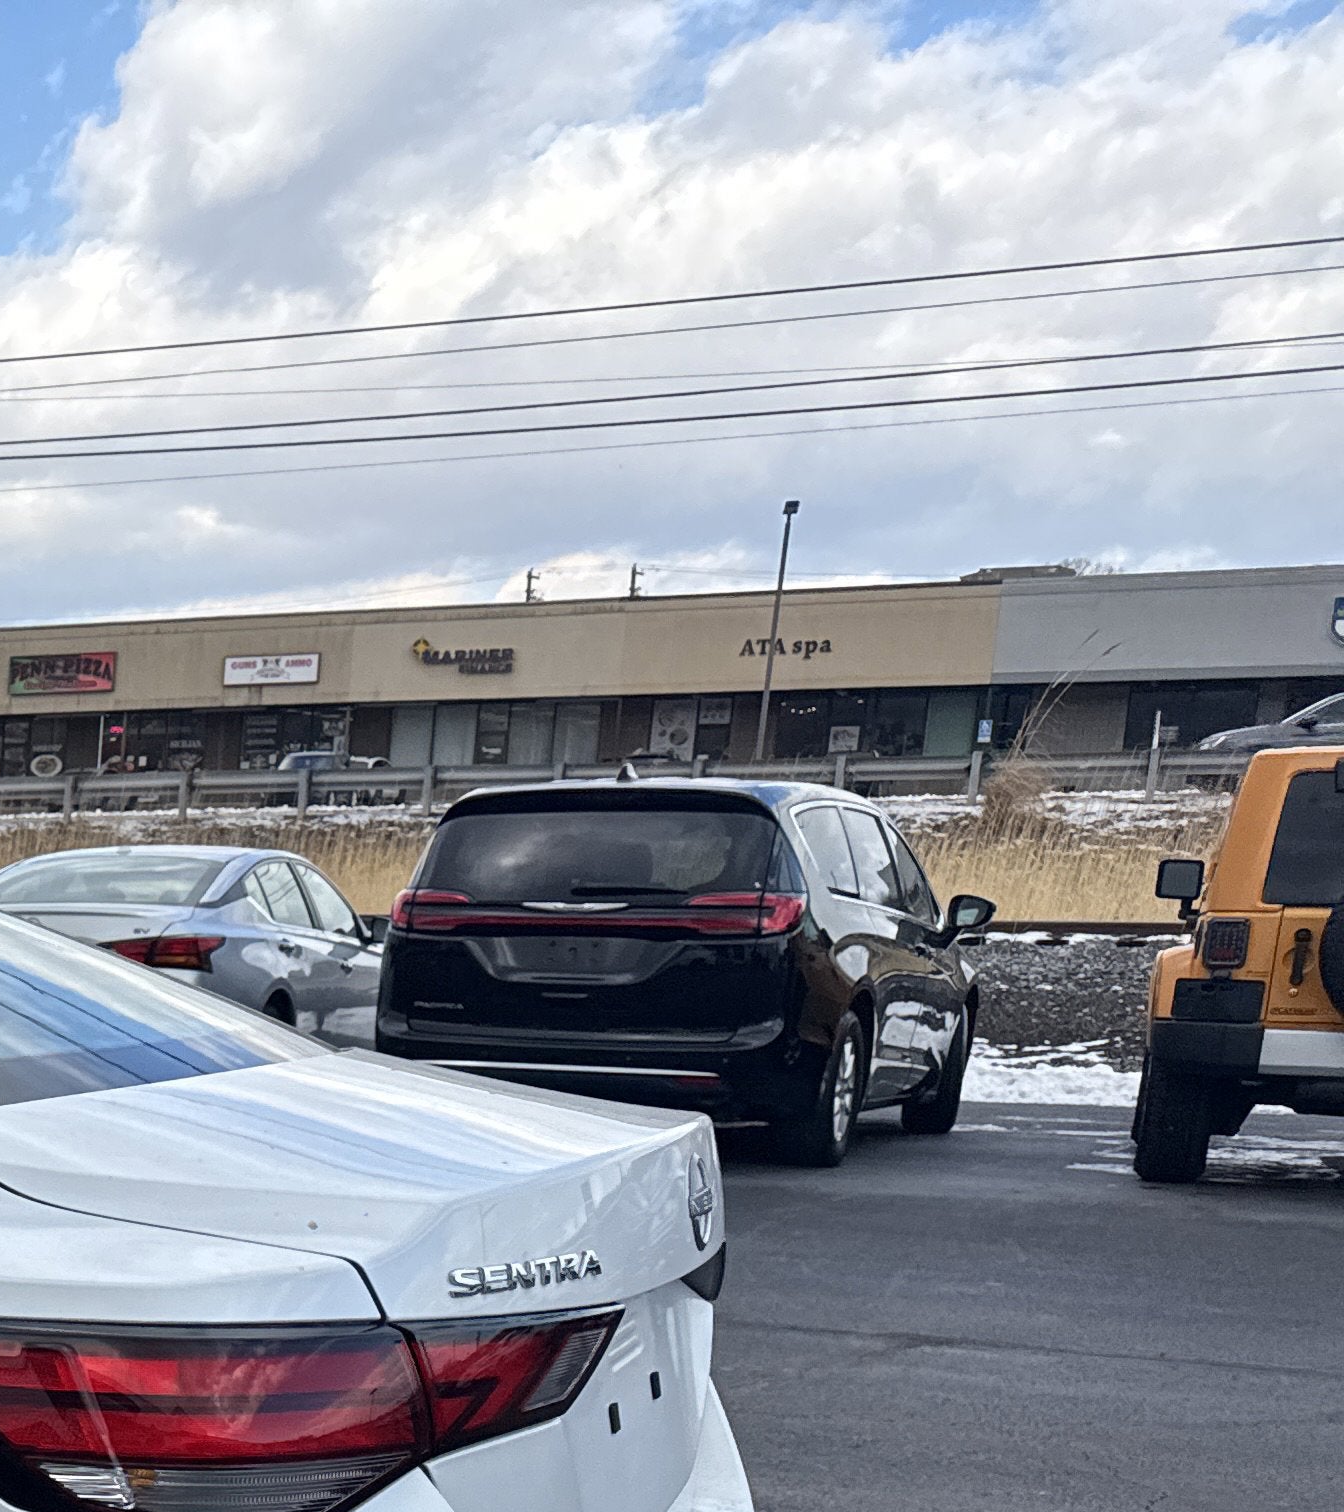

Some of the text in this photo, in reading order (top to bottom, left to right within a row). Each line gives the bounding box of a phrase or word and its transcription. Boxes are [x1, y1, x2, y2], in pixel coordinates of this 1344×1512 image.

[738, 638, 832, 660] ATA spa
[63, 657, 112, 681] PIZZA
[285, 658, 313, 668] AMMO
[447, 1249, 603, 1299] SENTRA
